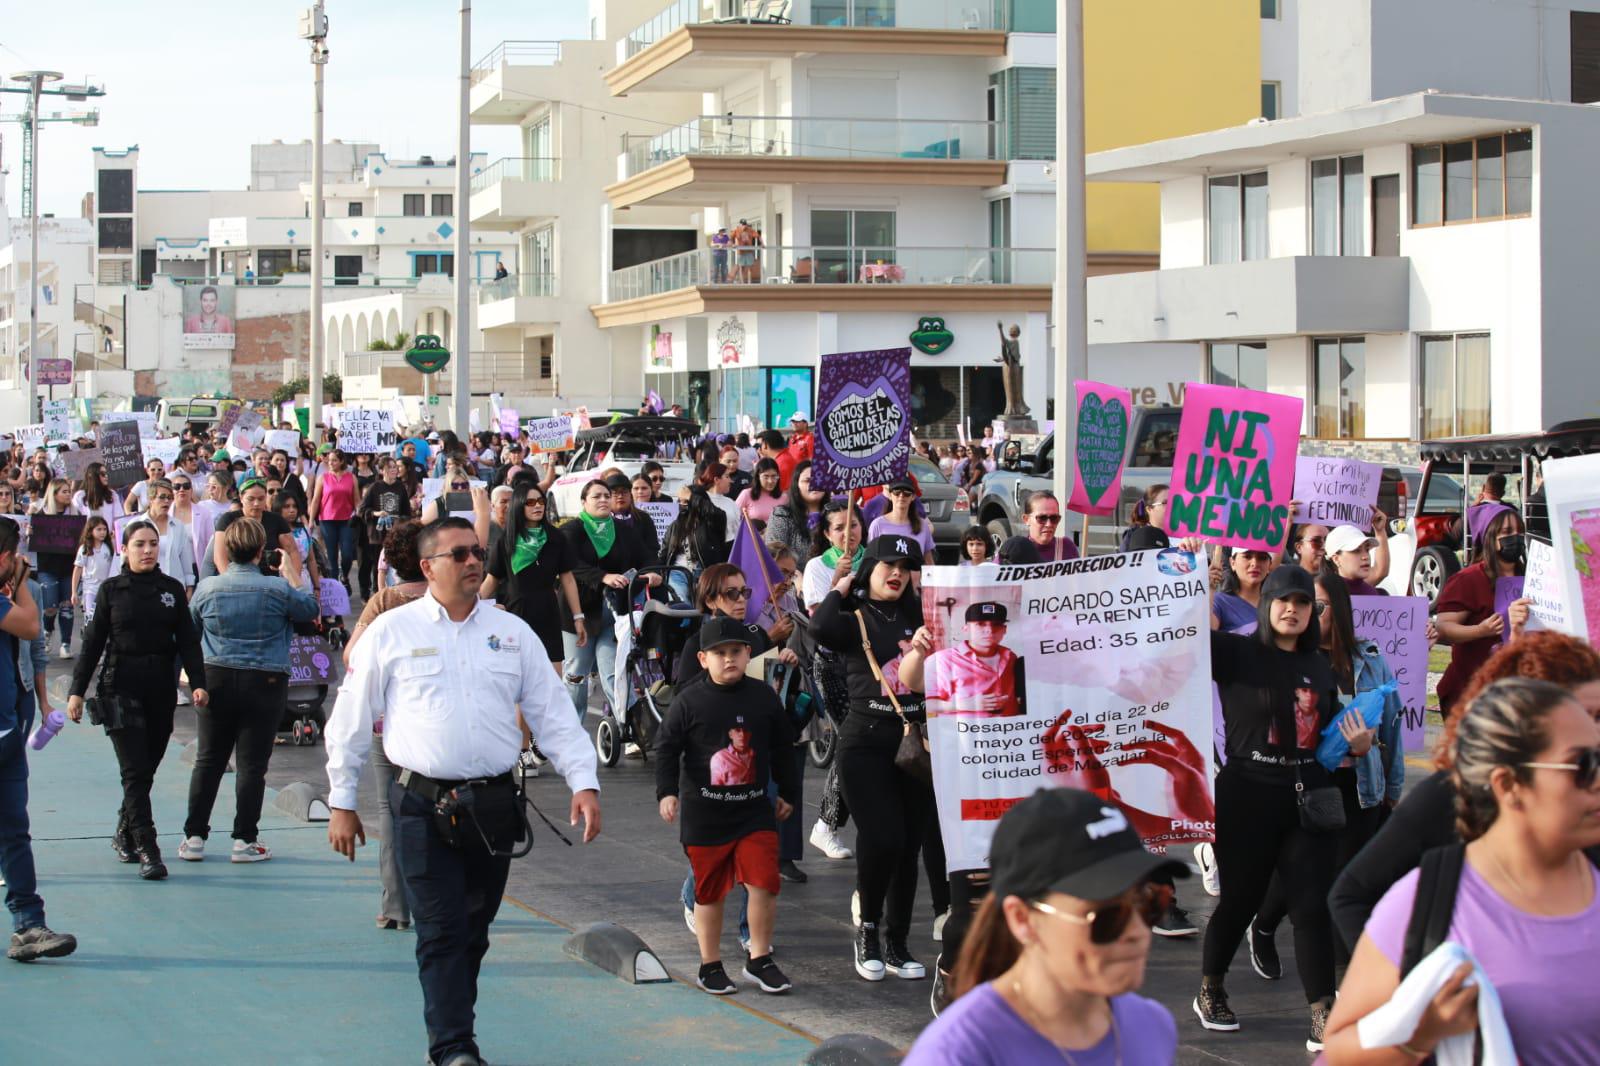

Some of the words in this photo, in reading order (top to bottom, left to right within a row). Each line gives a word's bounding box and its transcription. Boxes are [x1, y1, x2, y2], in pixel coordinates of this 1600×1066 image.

[1131, 387, 1156, 405] re
[1168, 382, 1186, 405] V
[377, 410, 390, 421] VA
[559, 416, 571, 426] NO
[827, 404, 864, 428] SOMOS
[867, 399, 884, 415] EL
[829, 419, 864, 440] GRITO
[865, 414, 879, 429] DE
[879, 403, 901, 424] LAS
[339, 422, 346, 430] A
[350, 422, 369, 430] SER
[372, 422, 384, 431] EL
[355, 430, 372, 440] QUE
[377, 432, 396, 446] NO
[1205, 408, 1270, 459] NI
[122, 444, 136, 455] que
[540, 438, 562, 449] TODO
[827, 459, 837, 474] Y
[833, 464, 850, 479] NO
[851, 465, 873, 478] NOS
[873, 442, 909, 473] VAMOS
[836, 479, 846, 490] A
[849, 468, 894, 489] CALLAR
[1185, 453, 1273, 502] UNA
[1169, 494, 1289, 546] MENOS
[1308, 501, 1370, 526] FEMINICIDIO
[1028, 591, 1114, 615] RICARDO
[1119, 579, 1206, 605] SARABIA
[1352, 607, 1392, 631] omos
[1396, 606, 1415, 631] el
[1039, 635, 1103, 655] Edad:
[1109, 632, 1138, 648] 35
[1146, 625, 1198, 644] años
[1385, 632, 1408, 657] de
[1074, 712, 1089, 725] el
[1095, 711, 1122, 723] día
[1127, 705, 1147, 719] 22
[1151, 701, 1170, 713] de
[961, 751, 1026, 765] colonia
[1032, 742, 1123, 761] Esperanza
[1129, 735, 1147, 746] de
[1152, 732, 1167, 743] la
[974, 737, 1023, 750] mayo
[1029, 733, 1056, 745] del
[1116, 723, 1136, 735] En
[982, 764, 1041, 780] ciudad
[1047, 763, 1069, 774] de
